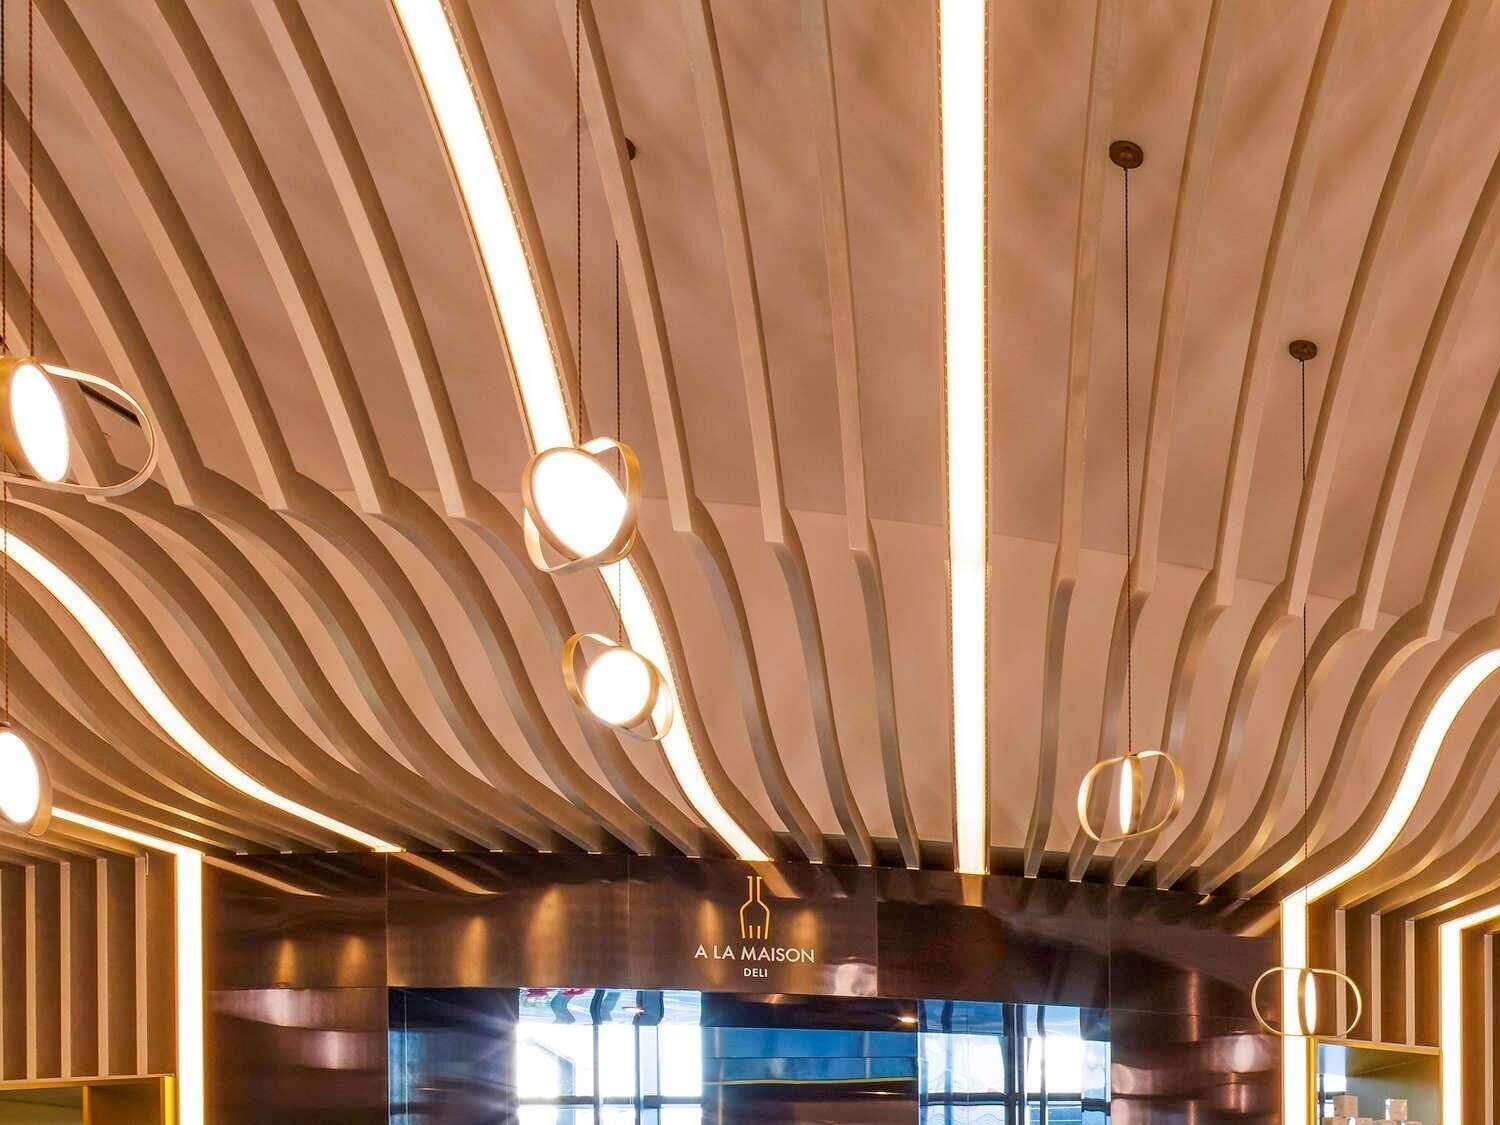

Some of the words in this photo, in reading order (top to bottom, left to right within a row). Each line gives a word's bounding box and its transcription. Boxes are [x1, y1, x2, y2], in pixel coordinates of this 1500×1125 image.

[694, 944, 708, 959] A
[713, 945, 735, 960] LA
[741, 946, 815, 963] MAISON
[743, 968, 768, 978] DELI
